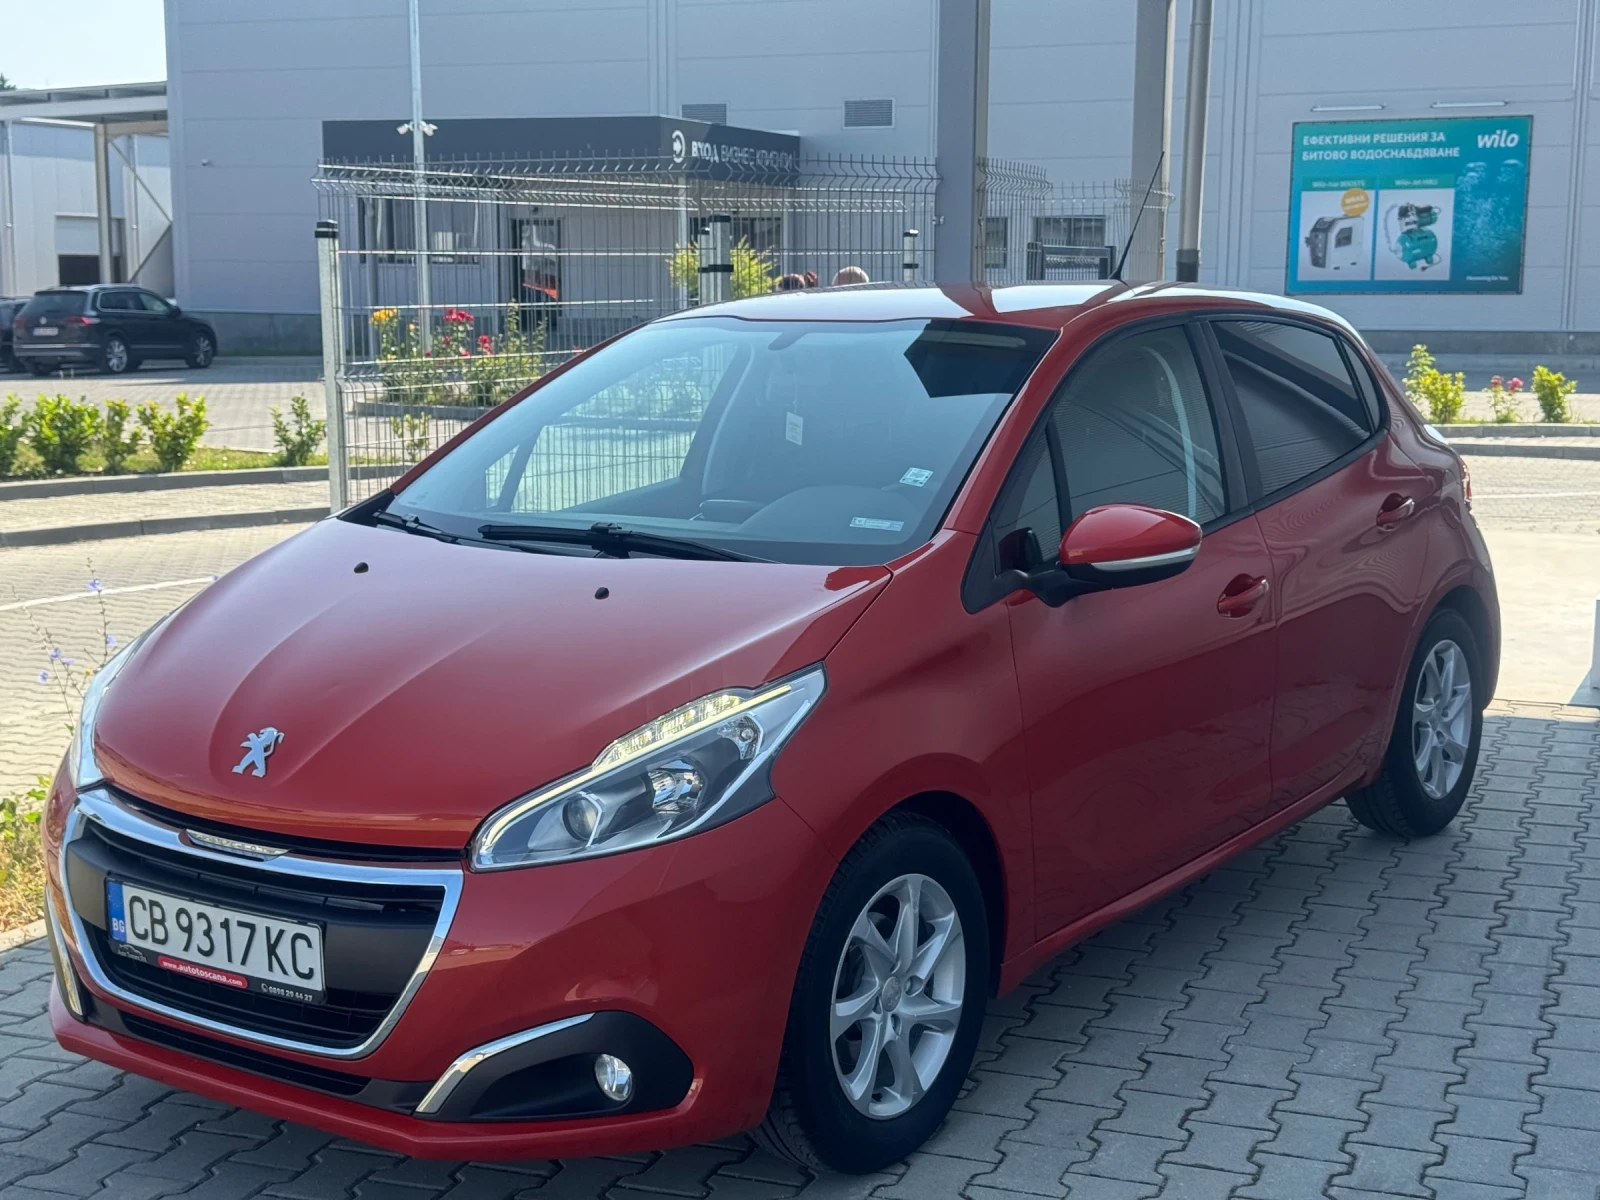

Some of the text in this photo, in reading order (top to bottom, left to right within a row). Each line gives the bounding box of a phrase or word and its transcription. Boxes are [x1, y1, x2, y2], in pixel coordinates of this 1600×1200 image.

[1302, 131, 1446, 146] ЕФЕКТИВНИ РЕШЕНИЯ ЗА
[1477, 129, 1519, 149] wilo
[1302, 146, 1460, 161] БИТОВО ВОДОСНАБДЯВАНЕ
[111, 917, 126, 933] BG
[162, 961, 244, 988] www.autotoscana.com
